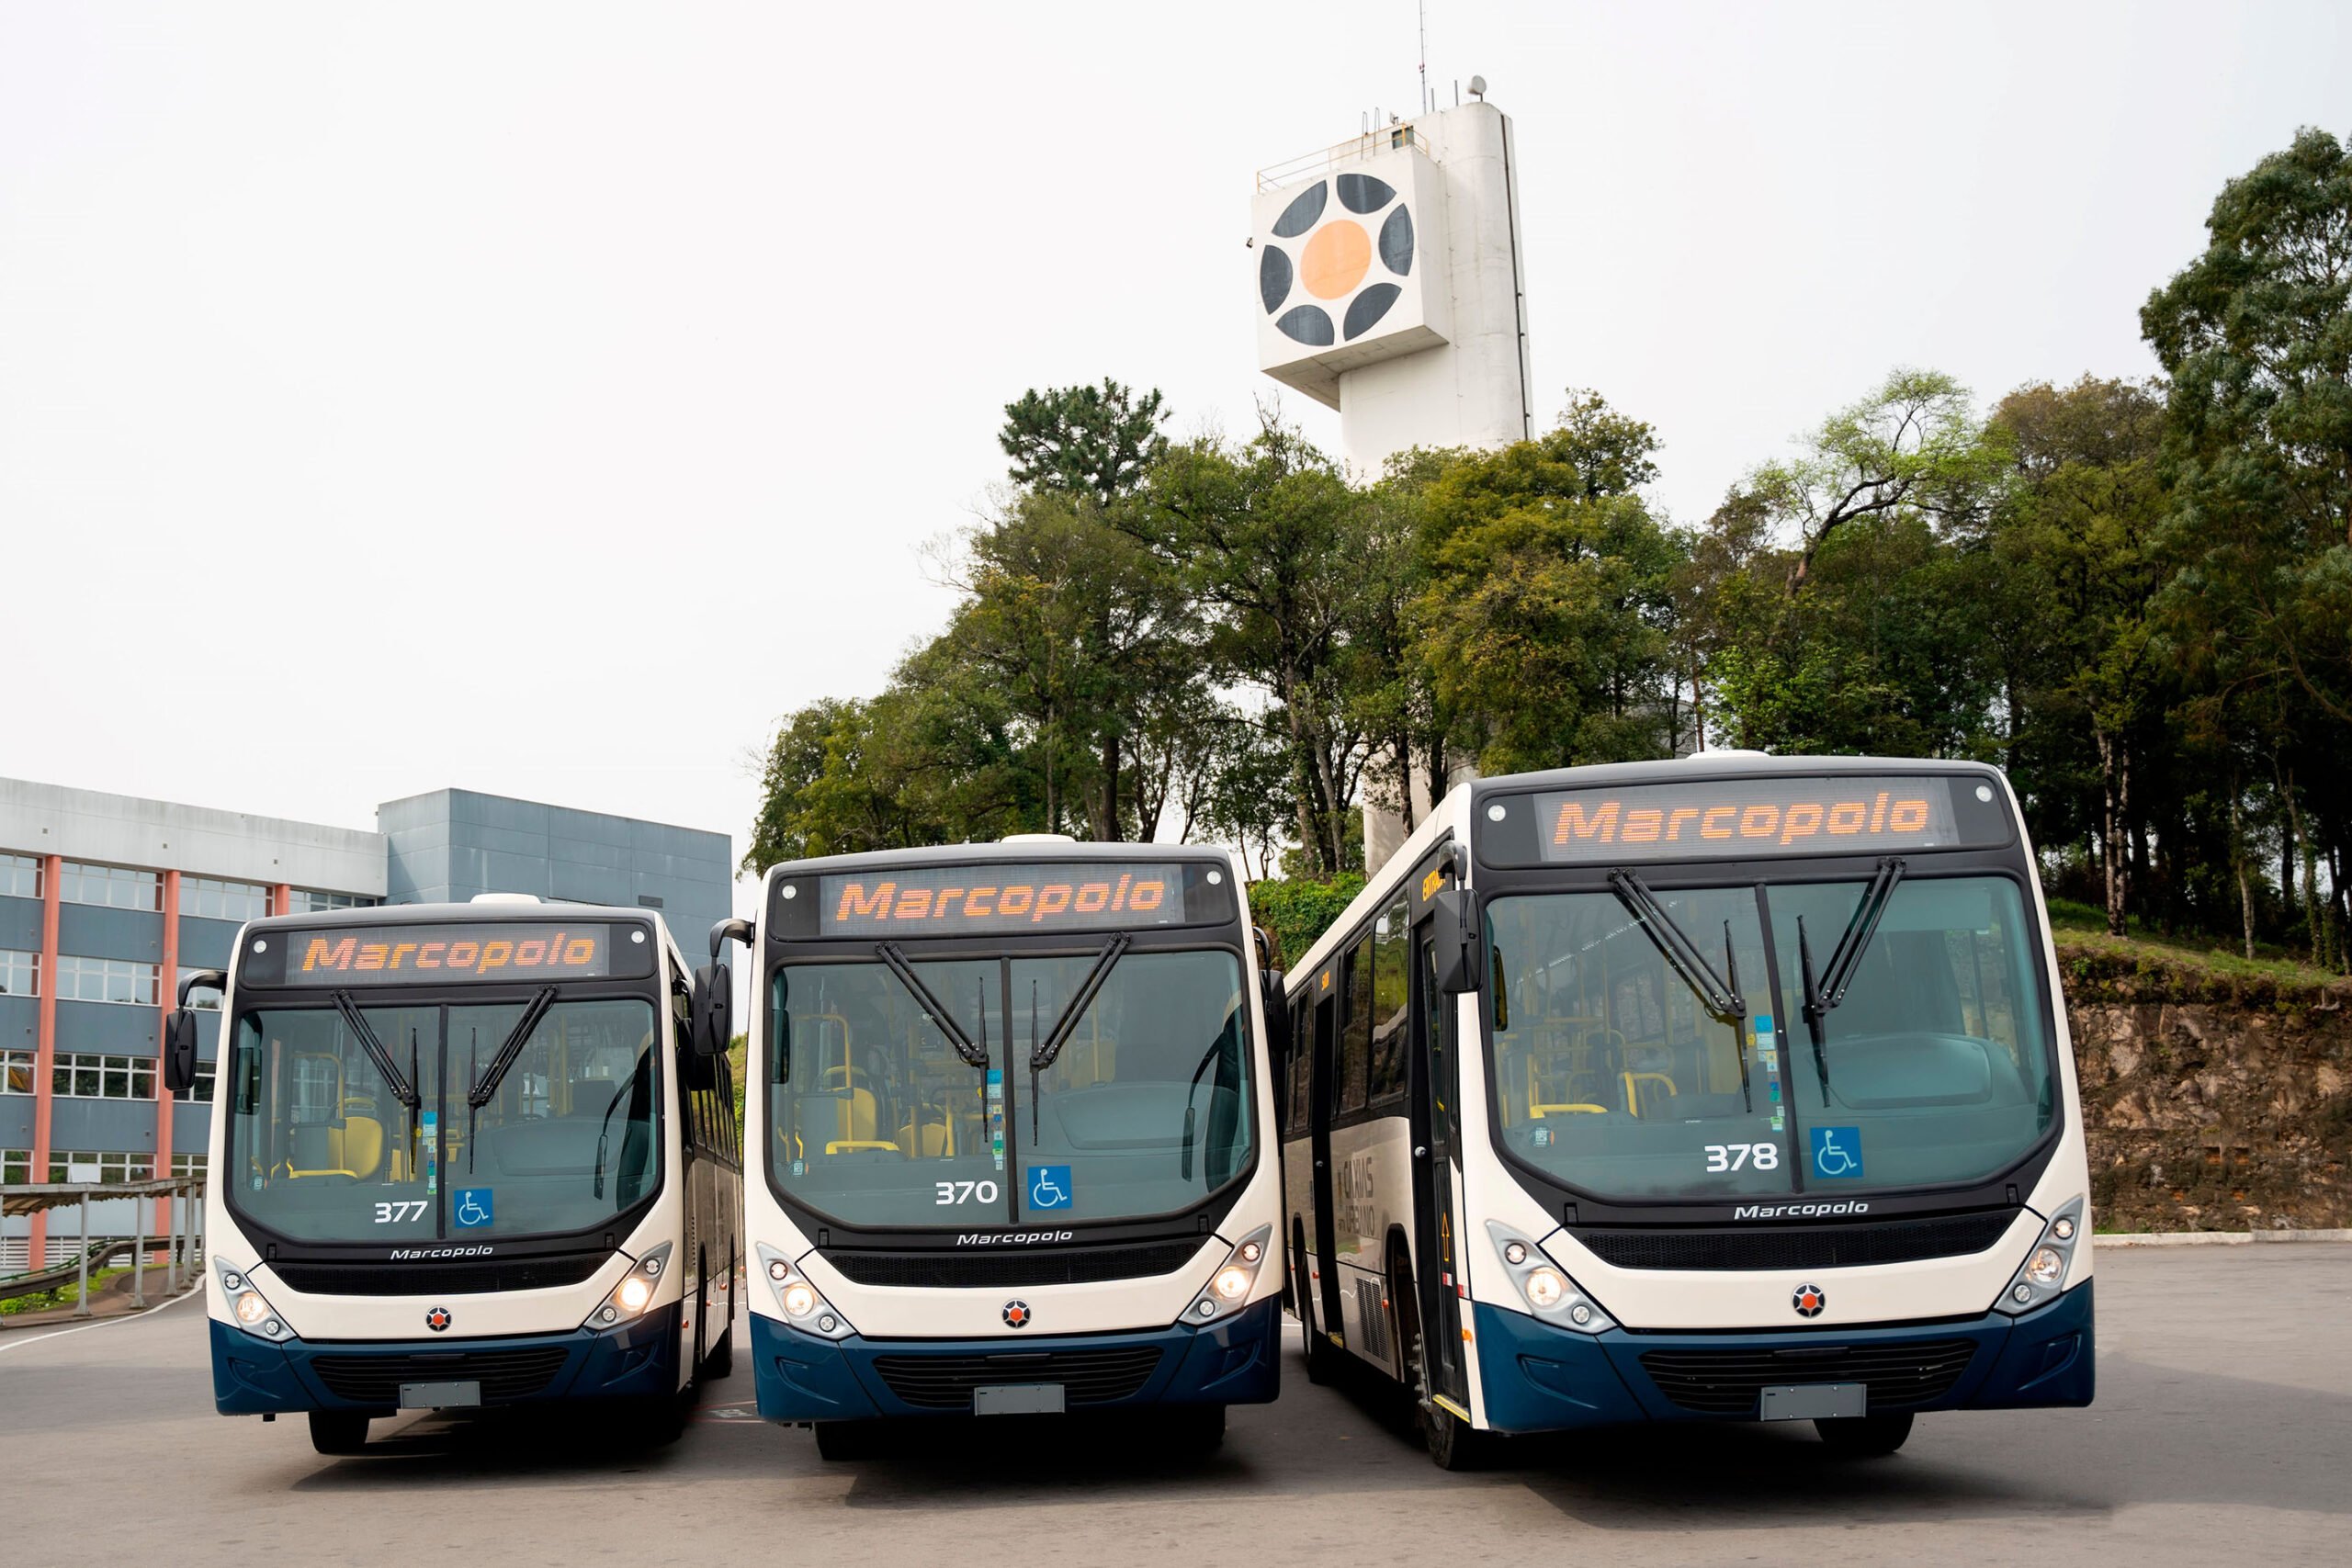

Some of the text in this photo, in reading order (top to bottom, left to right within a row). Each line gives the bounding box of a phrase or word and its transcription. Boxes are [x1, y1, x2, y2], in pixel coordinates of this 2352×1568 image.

[1554, 792, 1928, 845] Marcopolo
[836, 874, 1165, 922] Marcopolo
[302, 932, 595, 974] Marcopolo
[1704, 1143, 1779, 1172] 378
[935, 1180, 999, 1205] 370
[375, 1201, 428, 1223] 377
[1734, 1201, 1869, 1220] Marcopolo
[956, 1230, 1073, 1246] Marcopolo
[390, 1245, 493, 1260] Marcopolo
